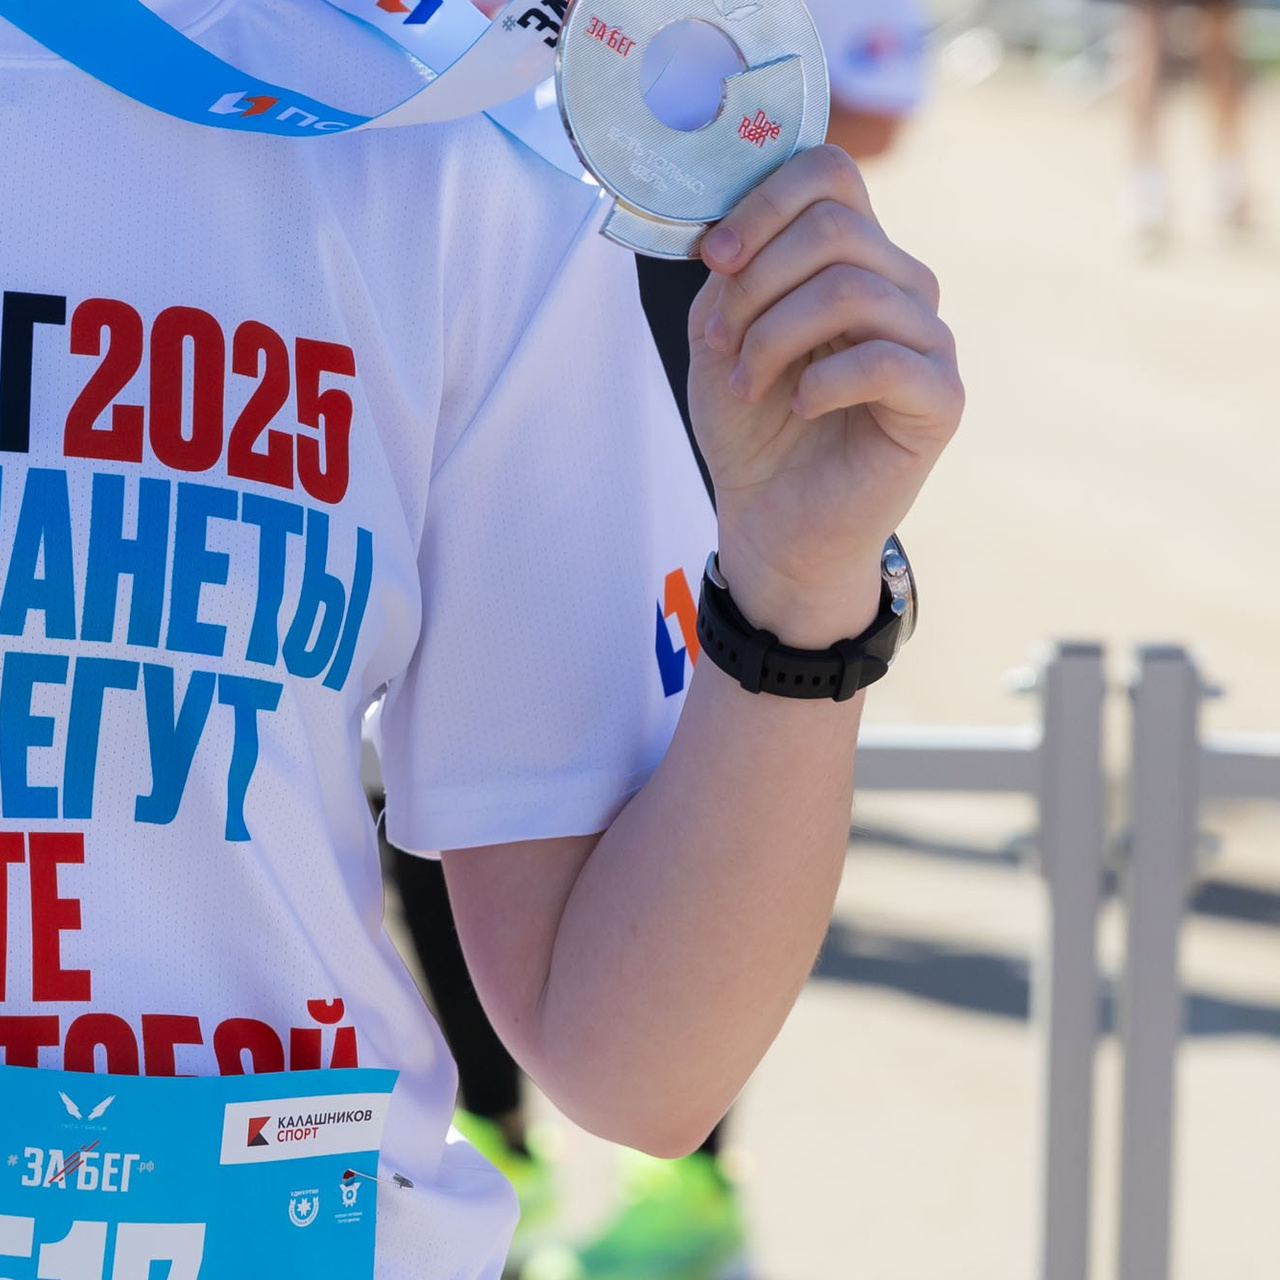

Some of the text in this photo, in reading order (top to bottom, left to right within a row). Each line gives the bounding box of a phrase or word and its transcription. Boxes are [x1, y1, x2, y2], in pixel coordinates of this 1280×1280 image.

[276, 106, 350, 131] ПС
[277, 1109, 373, 1129] КАЛАШНИКОВ
[276, 1127, 319, 1143] СПОРТ
